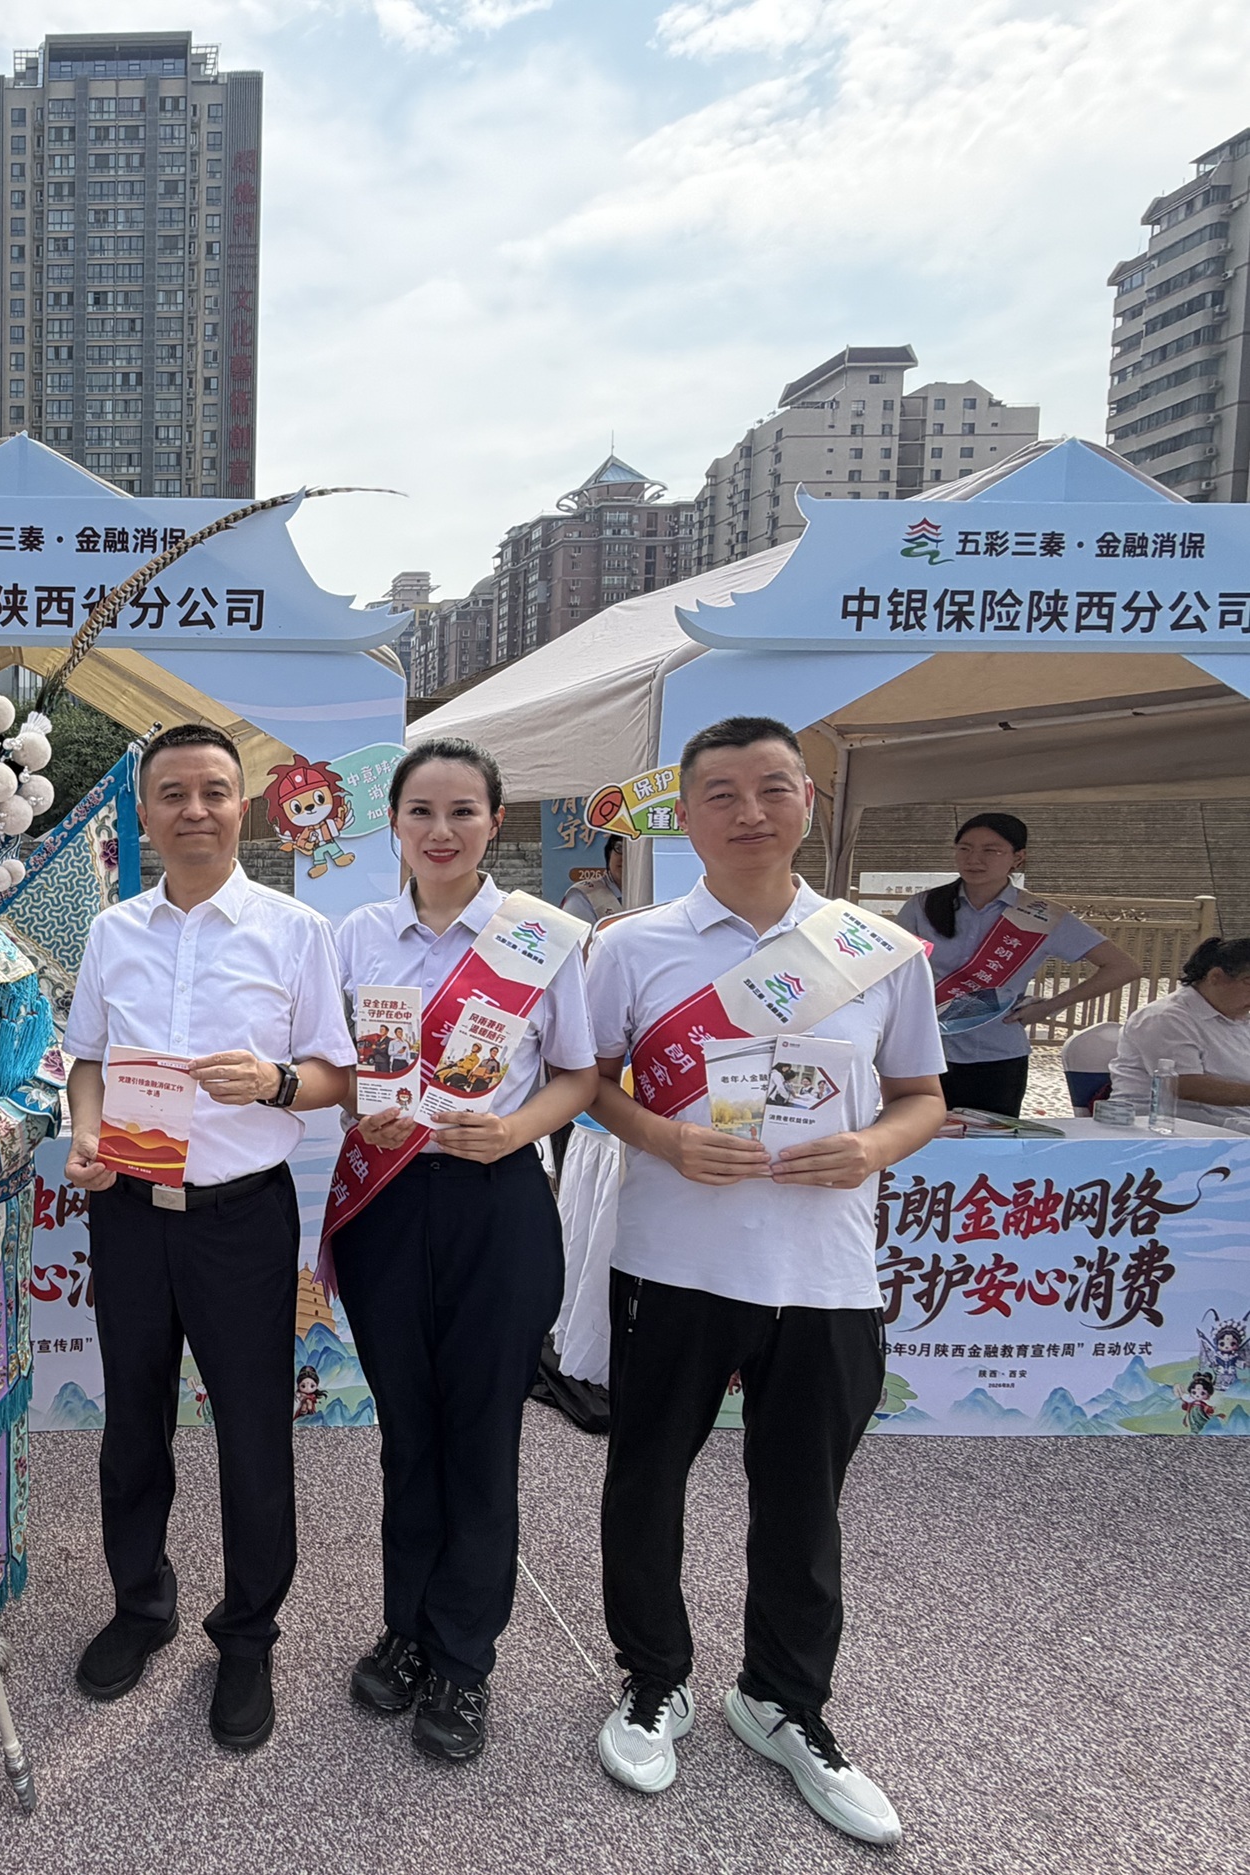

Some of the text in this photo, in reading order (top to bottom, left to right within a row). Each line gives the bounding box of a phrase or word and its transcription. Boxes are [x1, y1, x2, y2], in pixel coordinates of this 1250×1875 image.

[955, 530, 1205, 559] 五彩三秦·金融消保
[840, 586, 1250, 634] 中银保险陕西分公司
[632, 770, 681, 801] 保护
[647, 807, 682, 830] 谨
[578, 870, 607, 880] 2026
[363, 999, 407, 1010] 安全在路上
[368, 1009, 412, 1020] 守护在心中
[118, 1075, 184, 1093] 党建引领金融消保工作
[720, 1074, 772, 1084] 老年人金融
[139, 1089, 160, 1098] 一本通
[769, 1114, 815, 1125] 消费者权益保护
[876, 1239, 1176, 1332] 守护安心消费
[1092, 1341, 1153, 1357] 启动仪式
